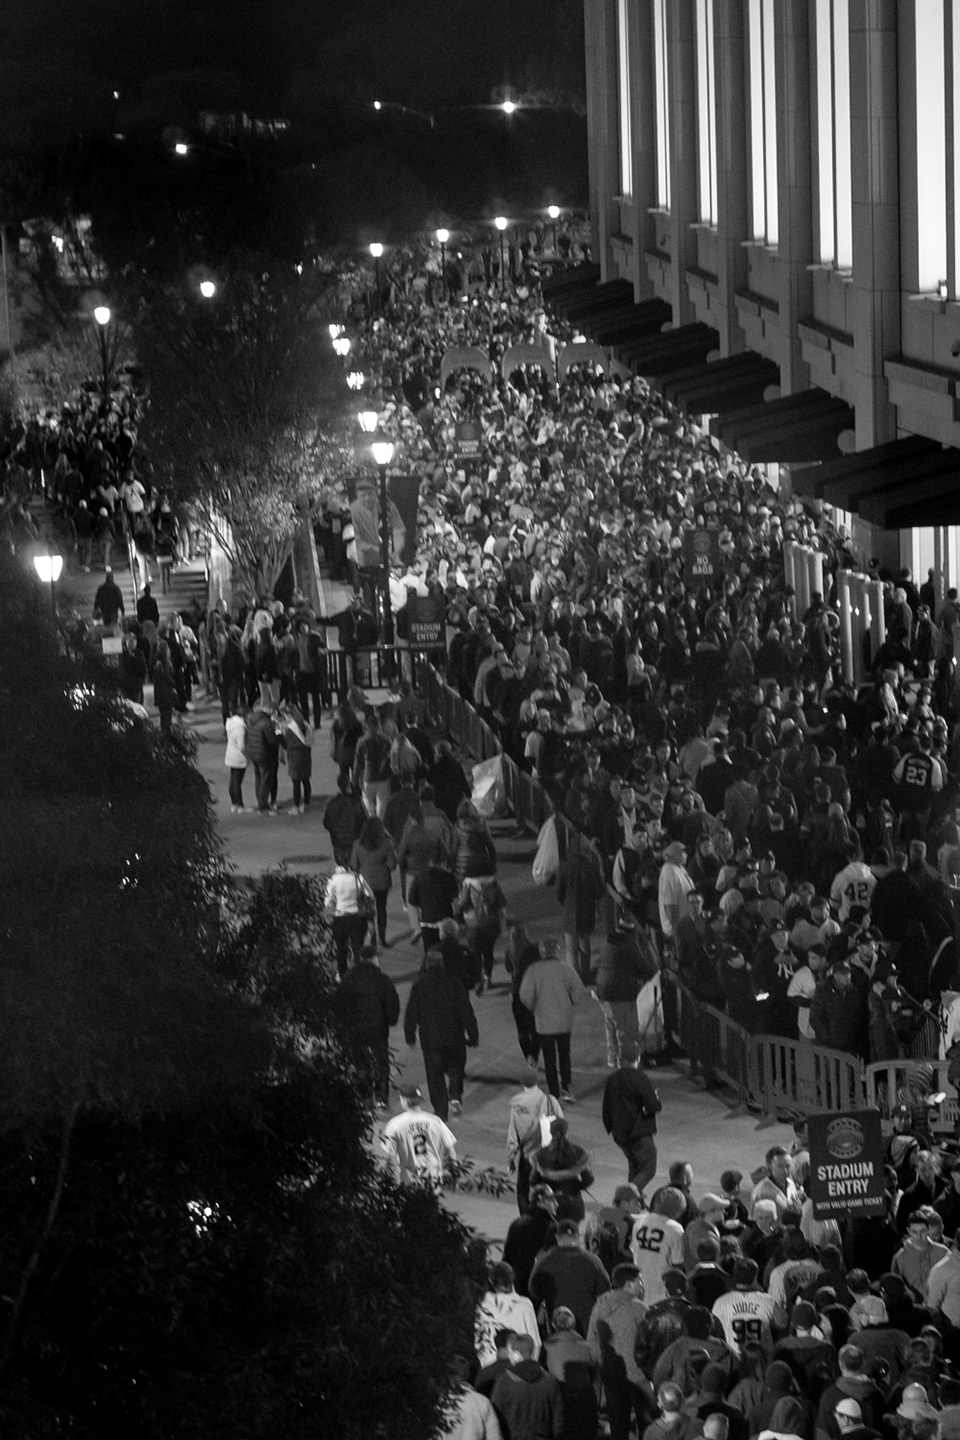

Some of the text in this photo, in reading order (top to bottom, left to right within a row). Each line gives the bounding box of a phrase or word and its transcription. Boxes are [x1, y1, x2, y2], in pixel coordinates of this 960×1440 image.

[696, 554, 709, 565] NO
[692, 564, 714, 576] BAGS
[410, 622, 441, 633] STADIUM
[416, 632, 438, 641] ENTRY
[905, 765, 928, 787] 23
[845, 882, 868, 902] 42
[413, 1134, 427, 1155] 2
[817, 1161, 874, 1181] STADIUM
[828, 1178, 869, 1197] ENTRY
[816, 1196, 883, 1211] WITH VALID GAME TICKET
[636, 1225, 665, 1253] 42
[732, 1302, 760, 1315] JUDGE
[732, 1319, 761, 1342] 99
